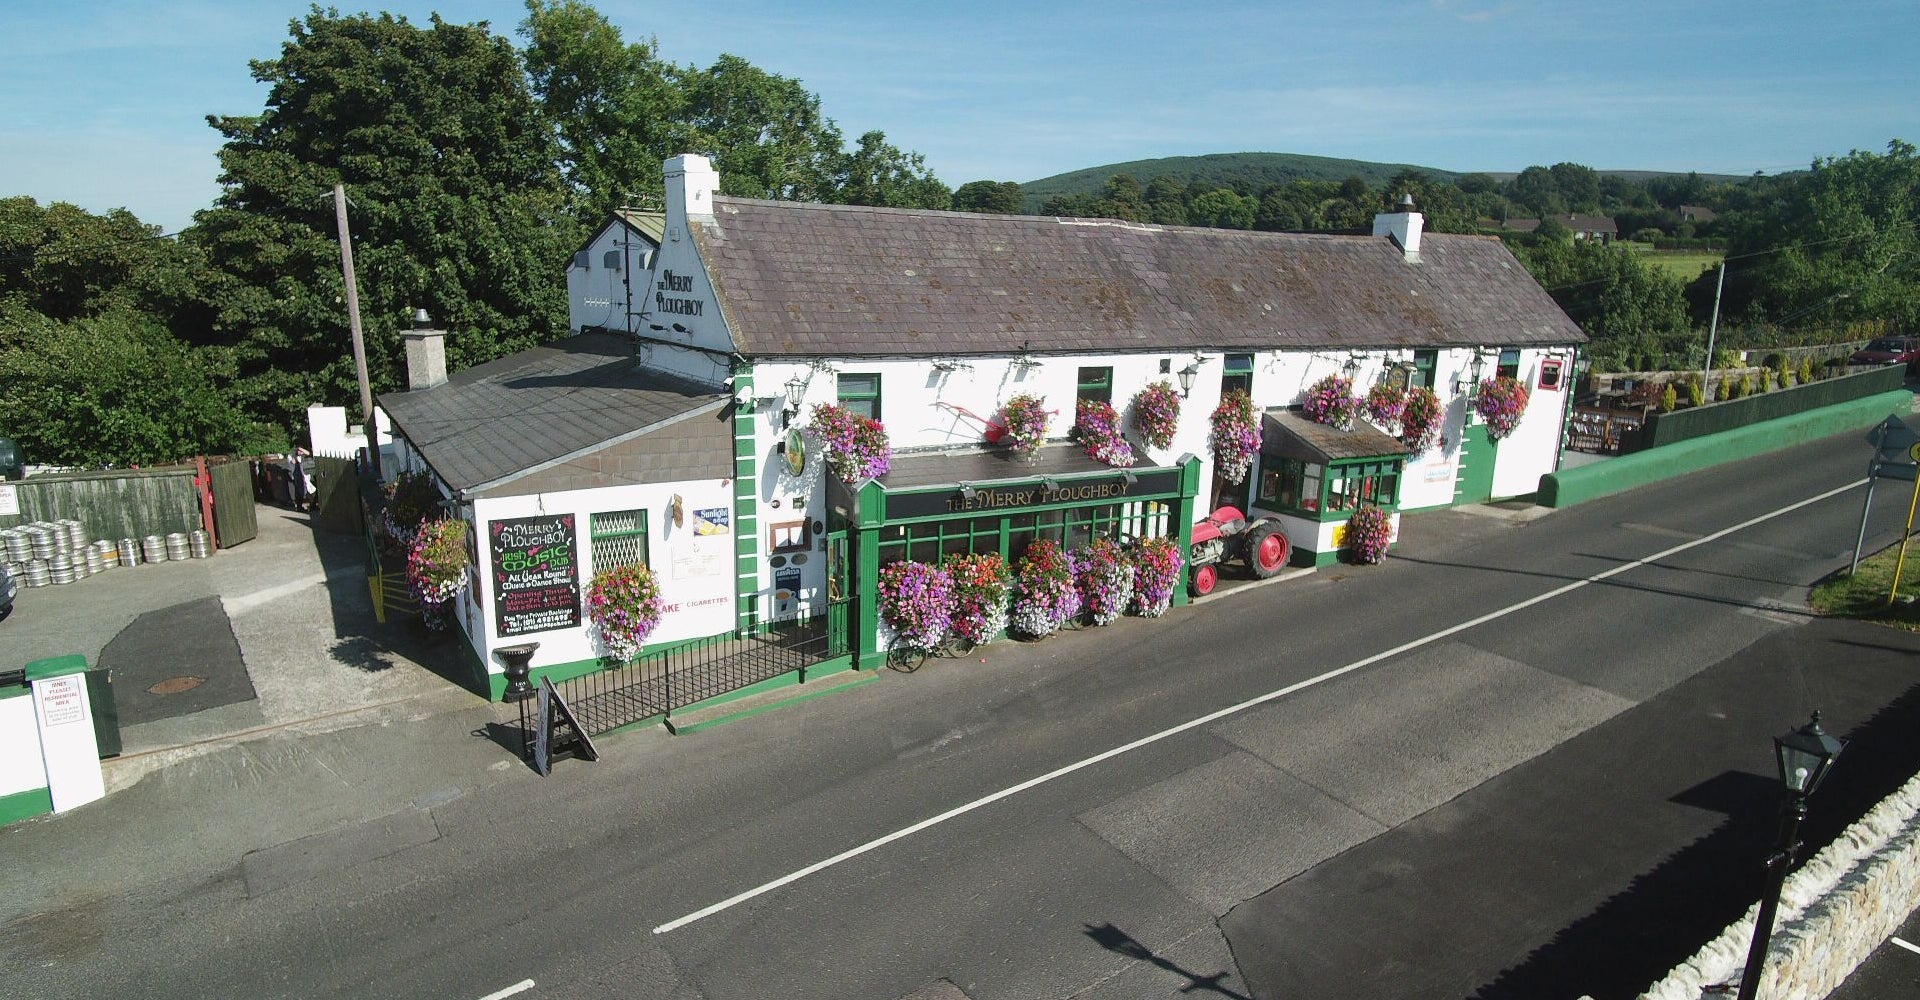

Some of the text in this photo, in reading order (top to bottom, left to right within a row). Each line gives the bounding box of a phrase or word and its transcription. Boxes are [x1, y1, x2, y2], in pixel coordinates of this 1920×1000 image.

[664, 269, 693, 292] MERRY
[656, 292, 703, 316] PLOUGHBOY
[946, 482, 1129, 511] THE MERRY PLOUGHBOY
[700, 507, 728, 519] Sunlight
[514, 523, 555, 535] MERRY
[500, 527, 566, 548] PLOUGHBOY
[544, 570, 566, 578] Round
[507, 591, 543, 600] Opening
[687, 597, 728, 607] CIGARETTES
